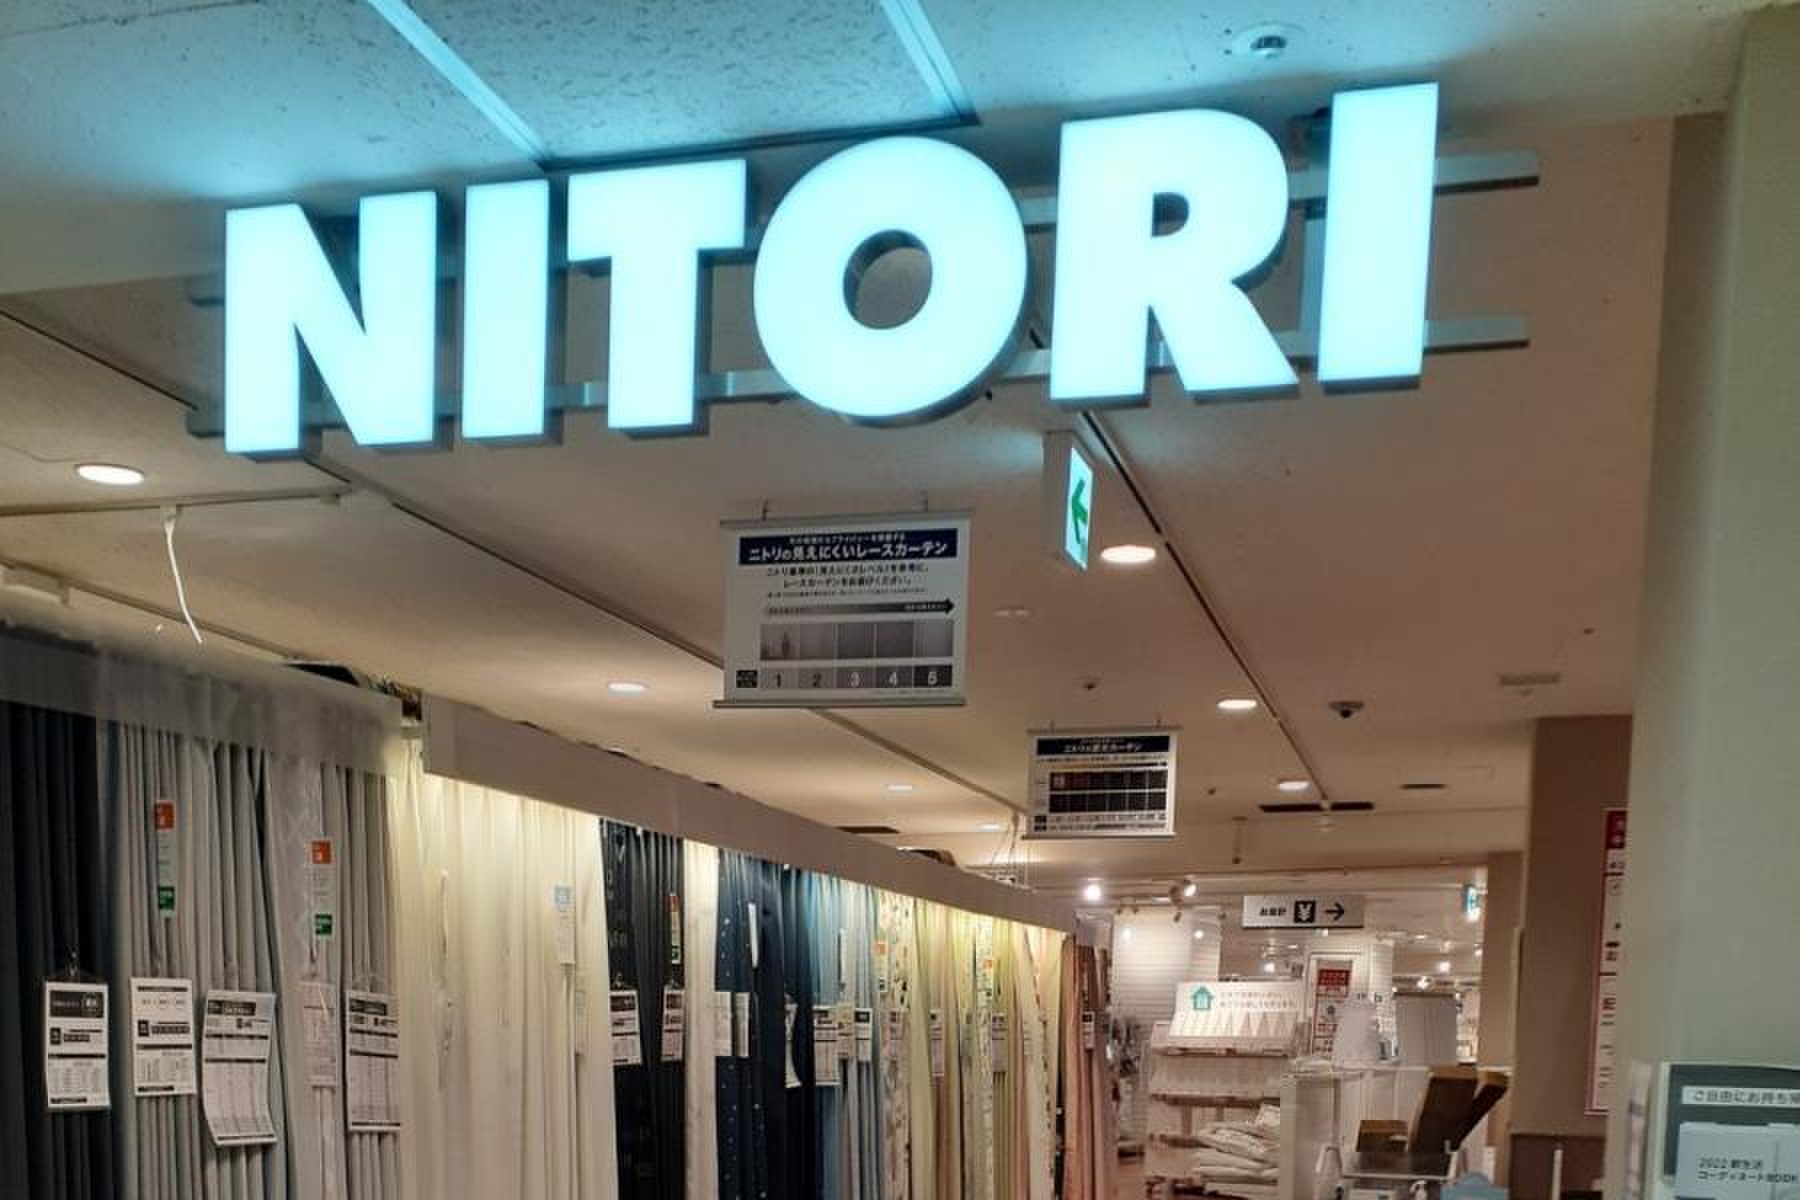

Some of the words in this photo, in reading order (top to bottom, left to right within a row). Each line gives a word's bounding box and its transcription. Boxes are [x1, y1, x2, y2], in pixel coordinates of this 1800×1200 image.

[224, 83, 1438, 454] NITORI
[748, 541, 948, 561] ニトリの見えにくいレースカーテン
[812, 673, 822, 687] 2
[850, 672, 860, 687] 3
[888, 671, 898, 685] 4
[927, 671, 938, 685] 5
